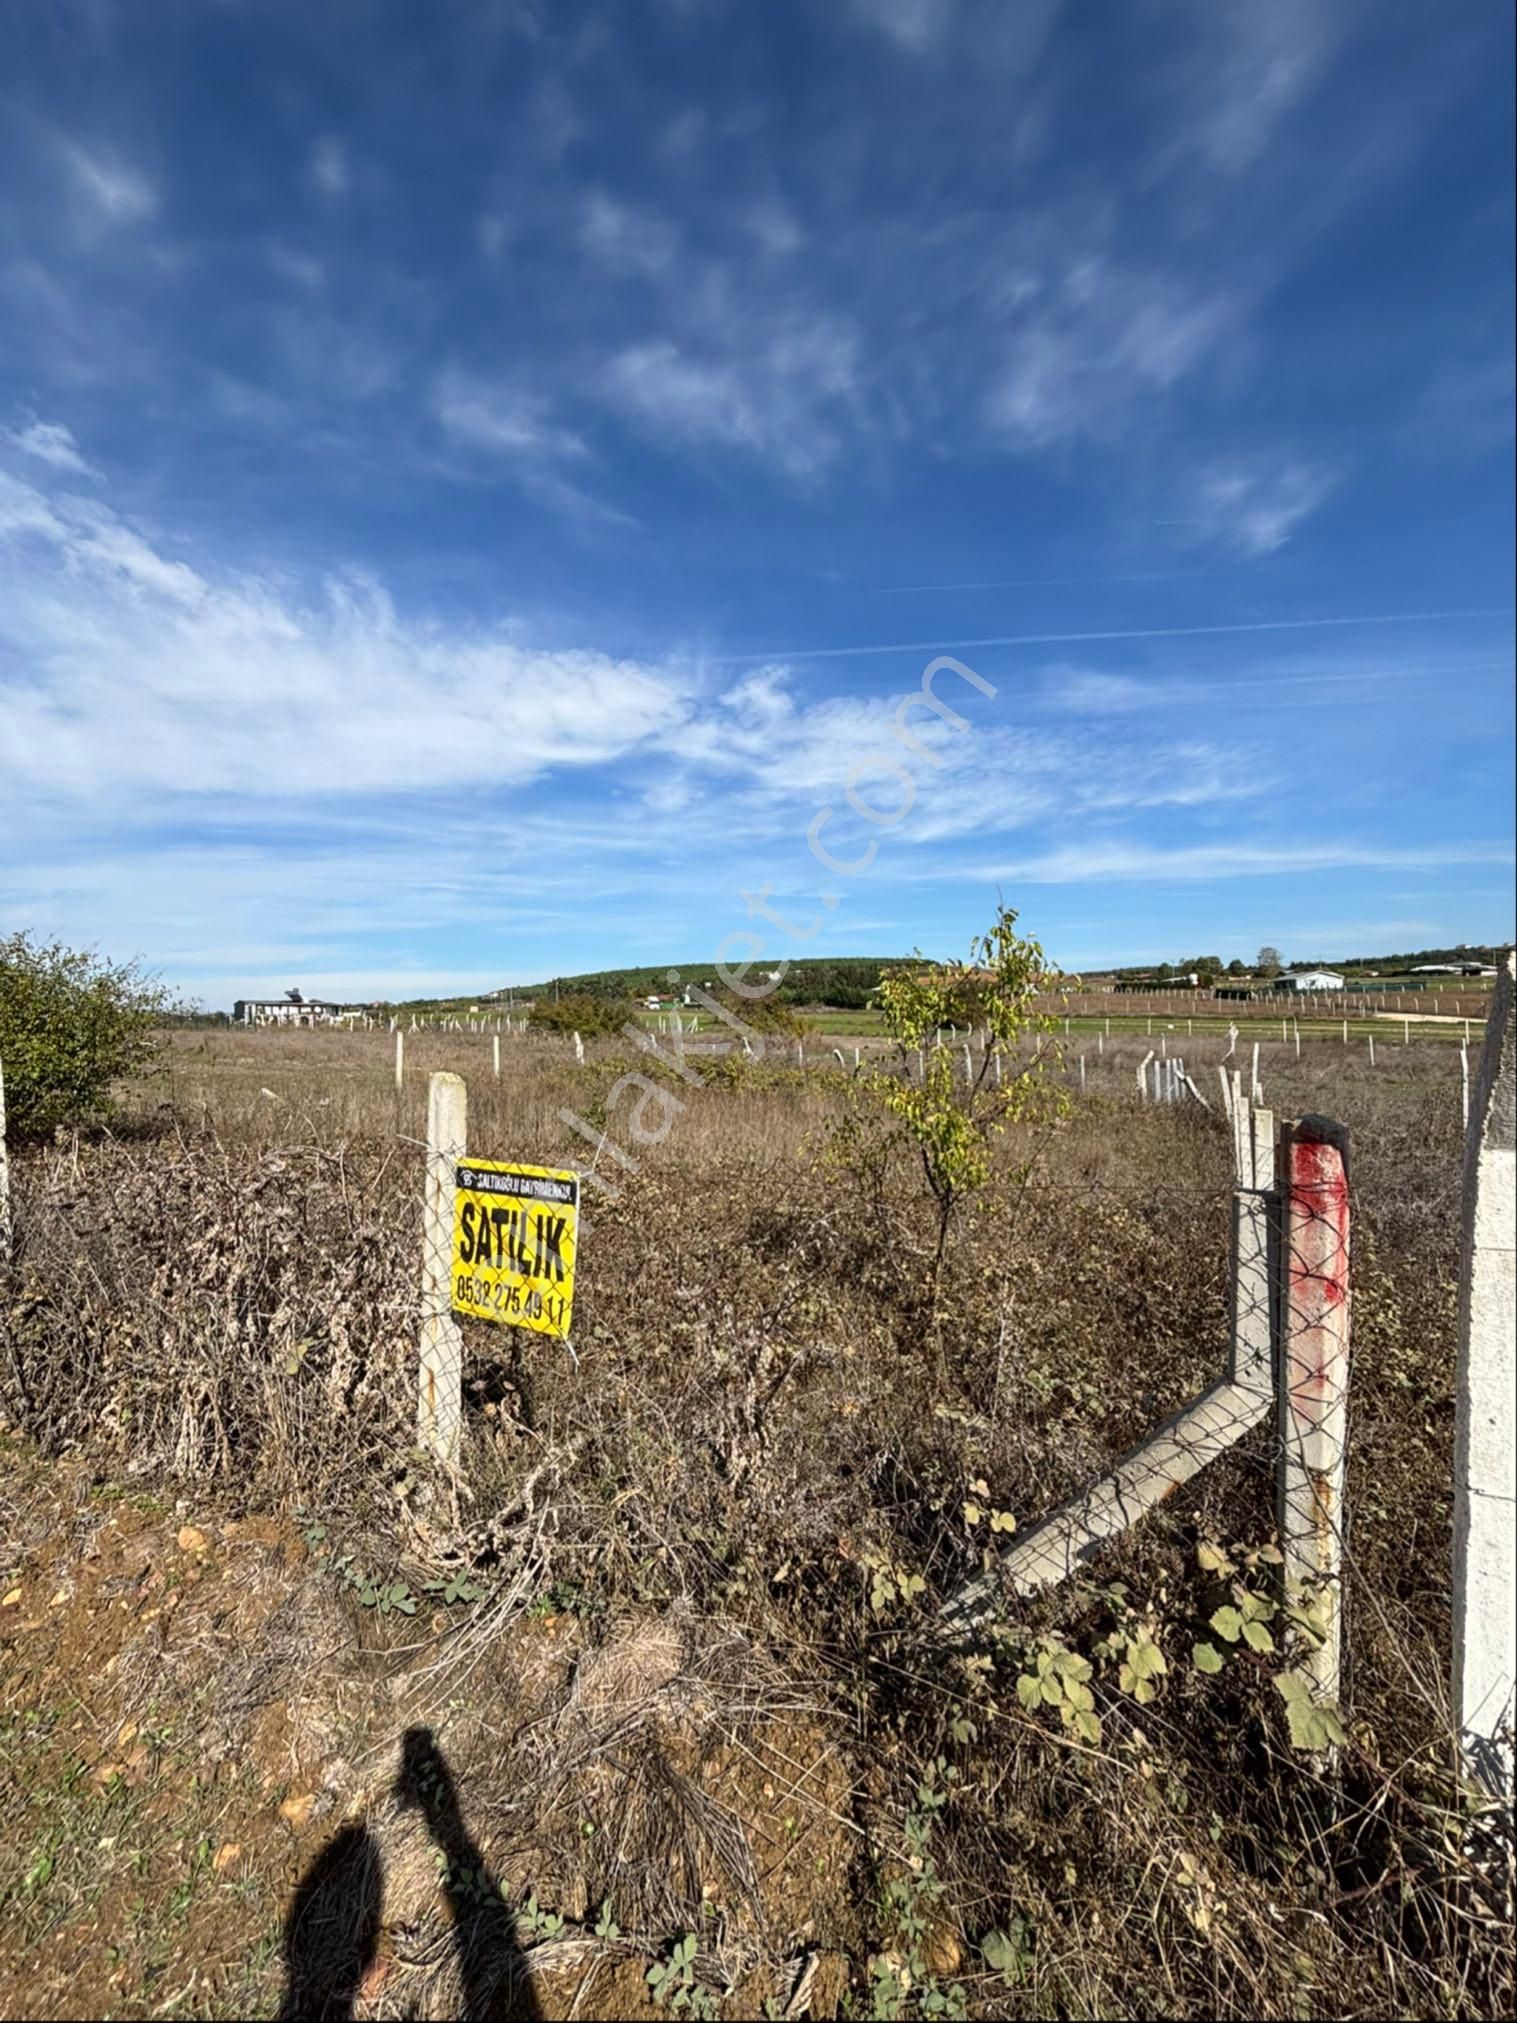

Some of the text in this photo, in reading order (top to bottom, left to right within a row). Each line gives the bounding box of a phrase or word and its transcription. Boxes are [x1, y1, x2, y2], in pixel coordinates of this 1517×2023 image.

[461, 1203, 567, 1281] SATILIK
[457, 1275, 564, 1325] 0532 275 49 11
